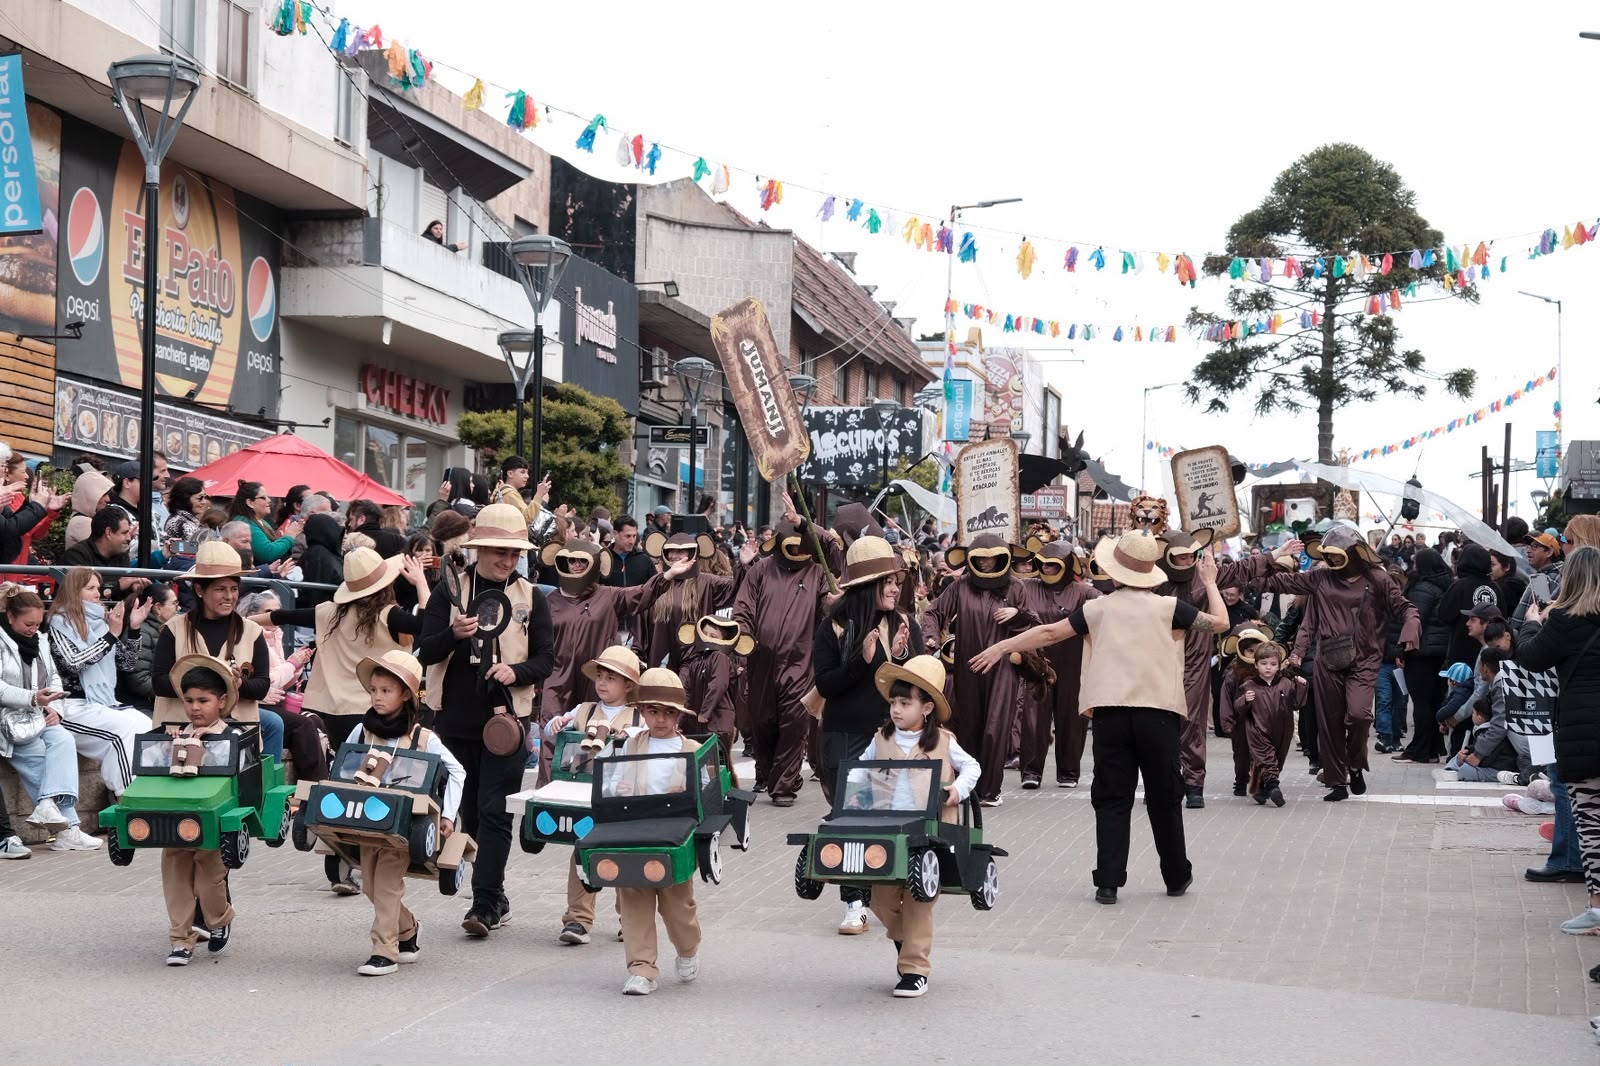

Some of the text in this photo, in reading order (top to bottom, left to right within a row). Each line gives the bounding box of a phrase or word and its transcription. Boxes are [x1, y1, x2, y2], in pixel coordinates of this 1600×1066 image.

[165, 227, 233, 314] Pato
[66, 294, 101, 323] pepsi
[129, 292, 223, 345] Pacheria Criolla
[247, 350, 274, 374] pepsi
[738, 338, 786, 438] JUMANJI
[986, 360, 1010, 380] PIZZA
[362, 364, 450, 425] CHEEKY
[953, 383, 965, 438] personal
[1199, 518, 1226, 529] JUMANJI
